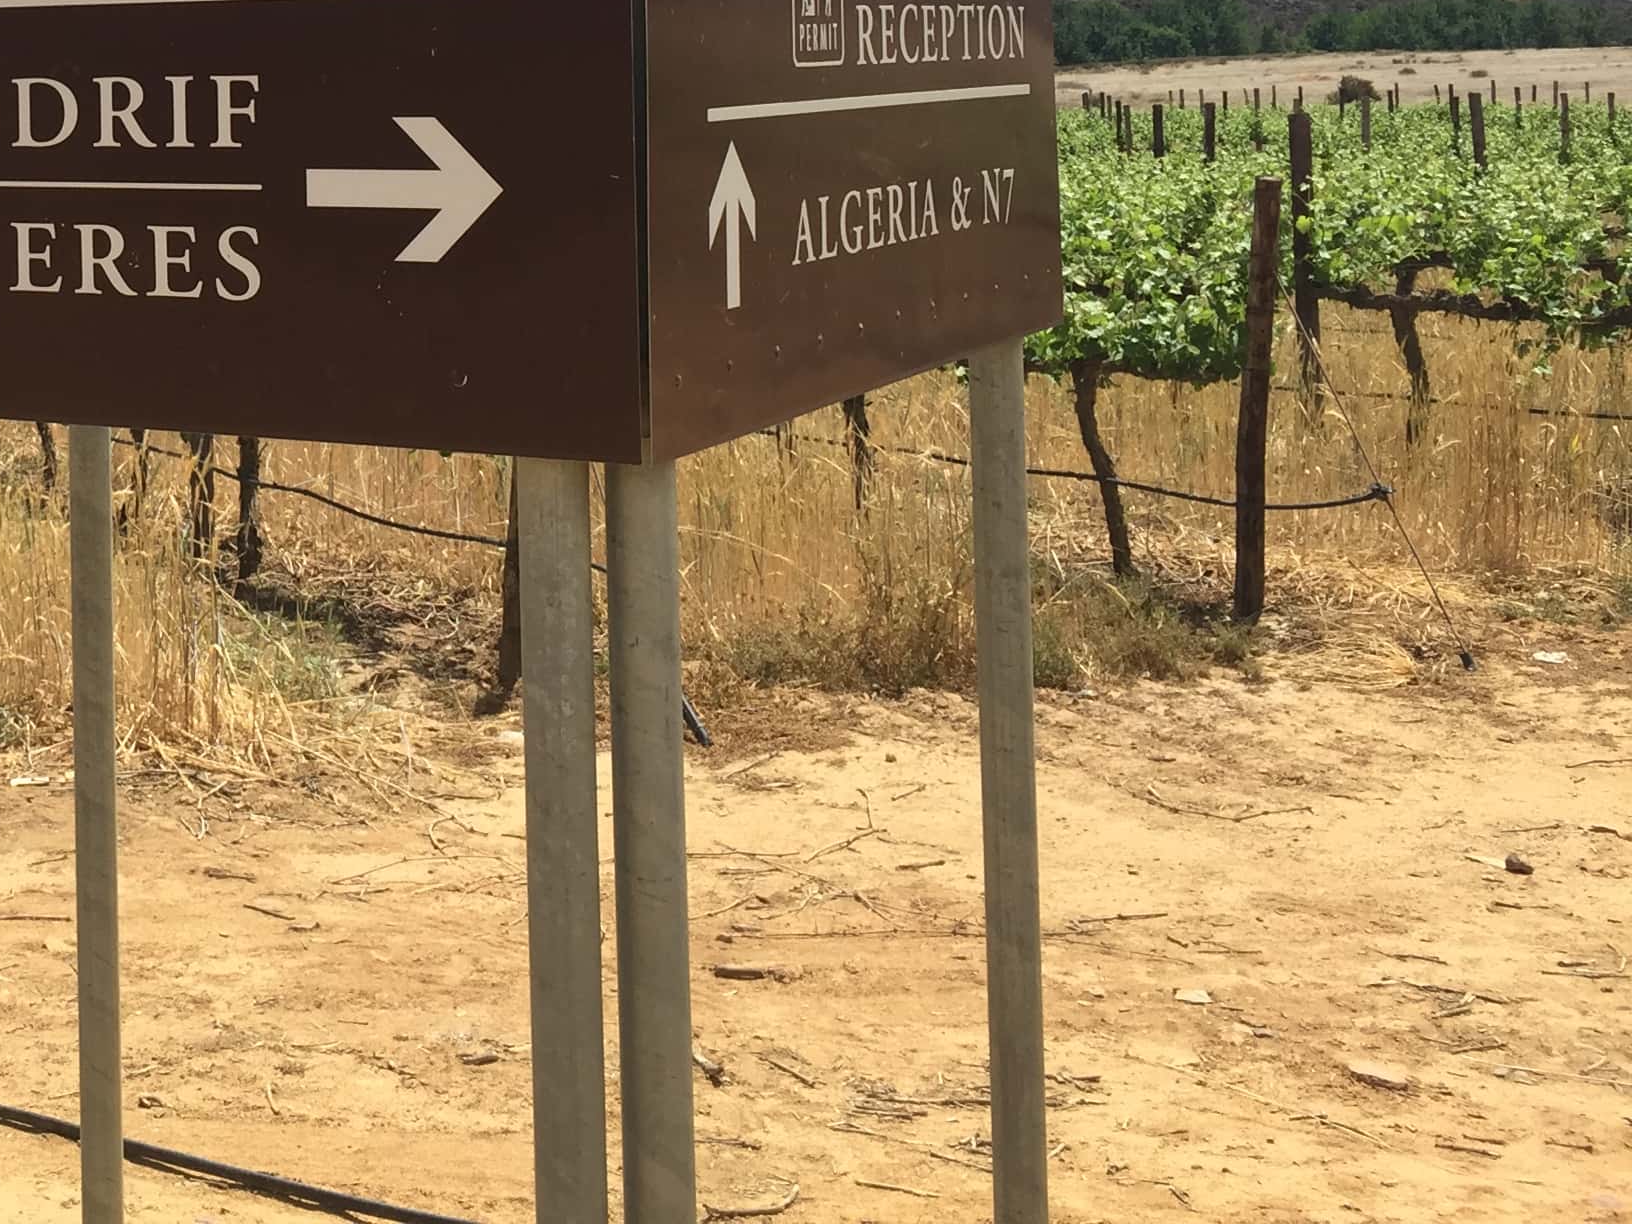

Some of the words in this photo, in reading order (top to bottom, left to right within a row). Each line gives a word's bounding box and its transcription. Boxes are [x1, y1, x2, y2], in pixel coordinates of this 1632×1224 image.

[800, 23, 837, 51] PERMIT
[856, 4, 1024, 65] RECEPTION
[792, 179, 939, 265] ALGERIA
[951, 177, 971, 231] &
[981, 168, 1014, 224] N7
